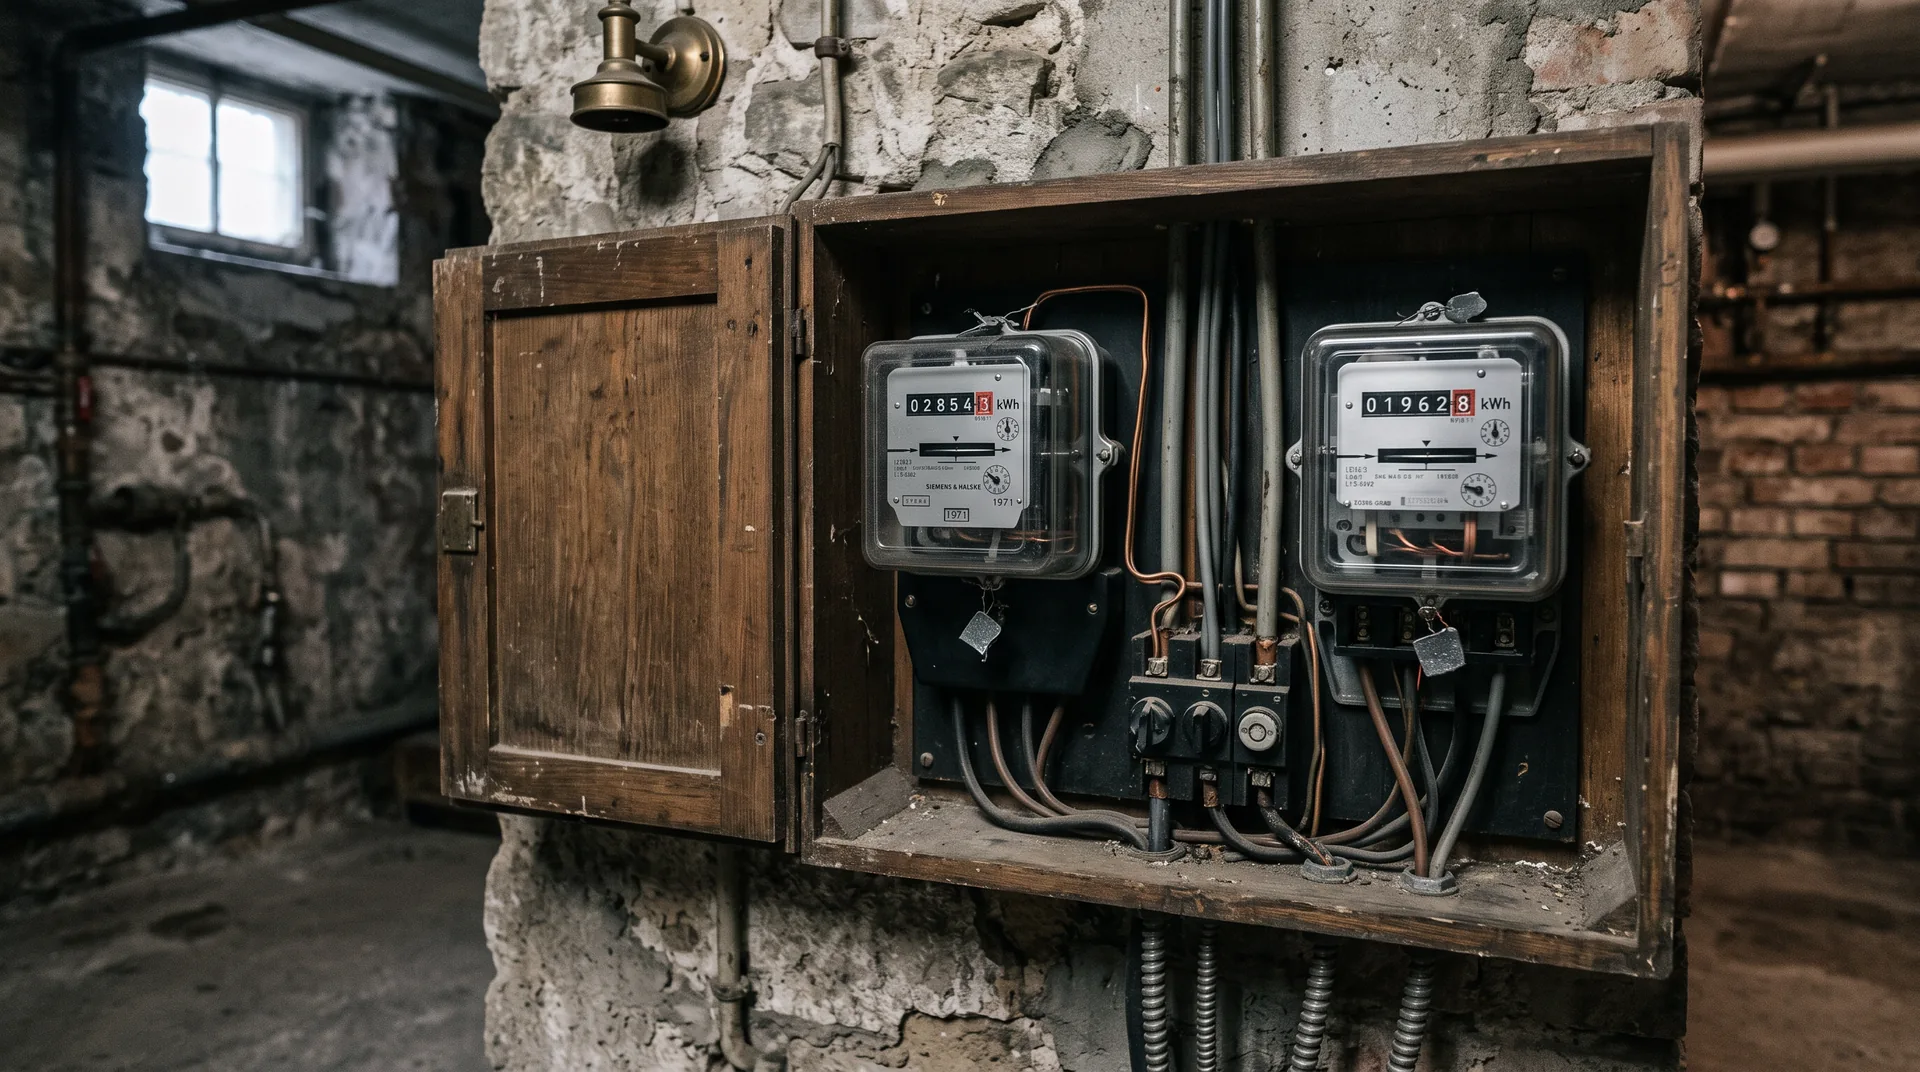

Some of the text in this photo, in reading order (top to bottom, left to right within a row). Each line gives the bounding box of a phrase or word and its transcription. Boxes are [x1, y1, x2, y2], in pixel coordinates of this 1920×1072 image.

[996, 399, 1020, 410] kWh
[1480, 397, 1511, 410] kWh
[993, 498, 1013, 506] 1971
[946, 510, 967, 519] 1971
